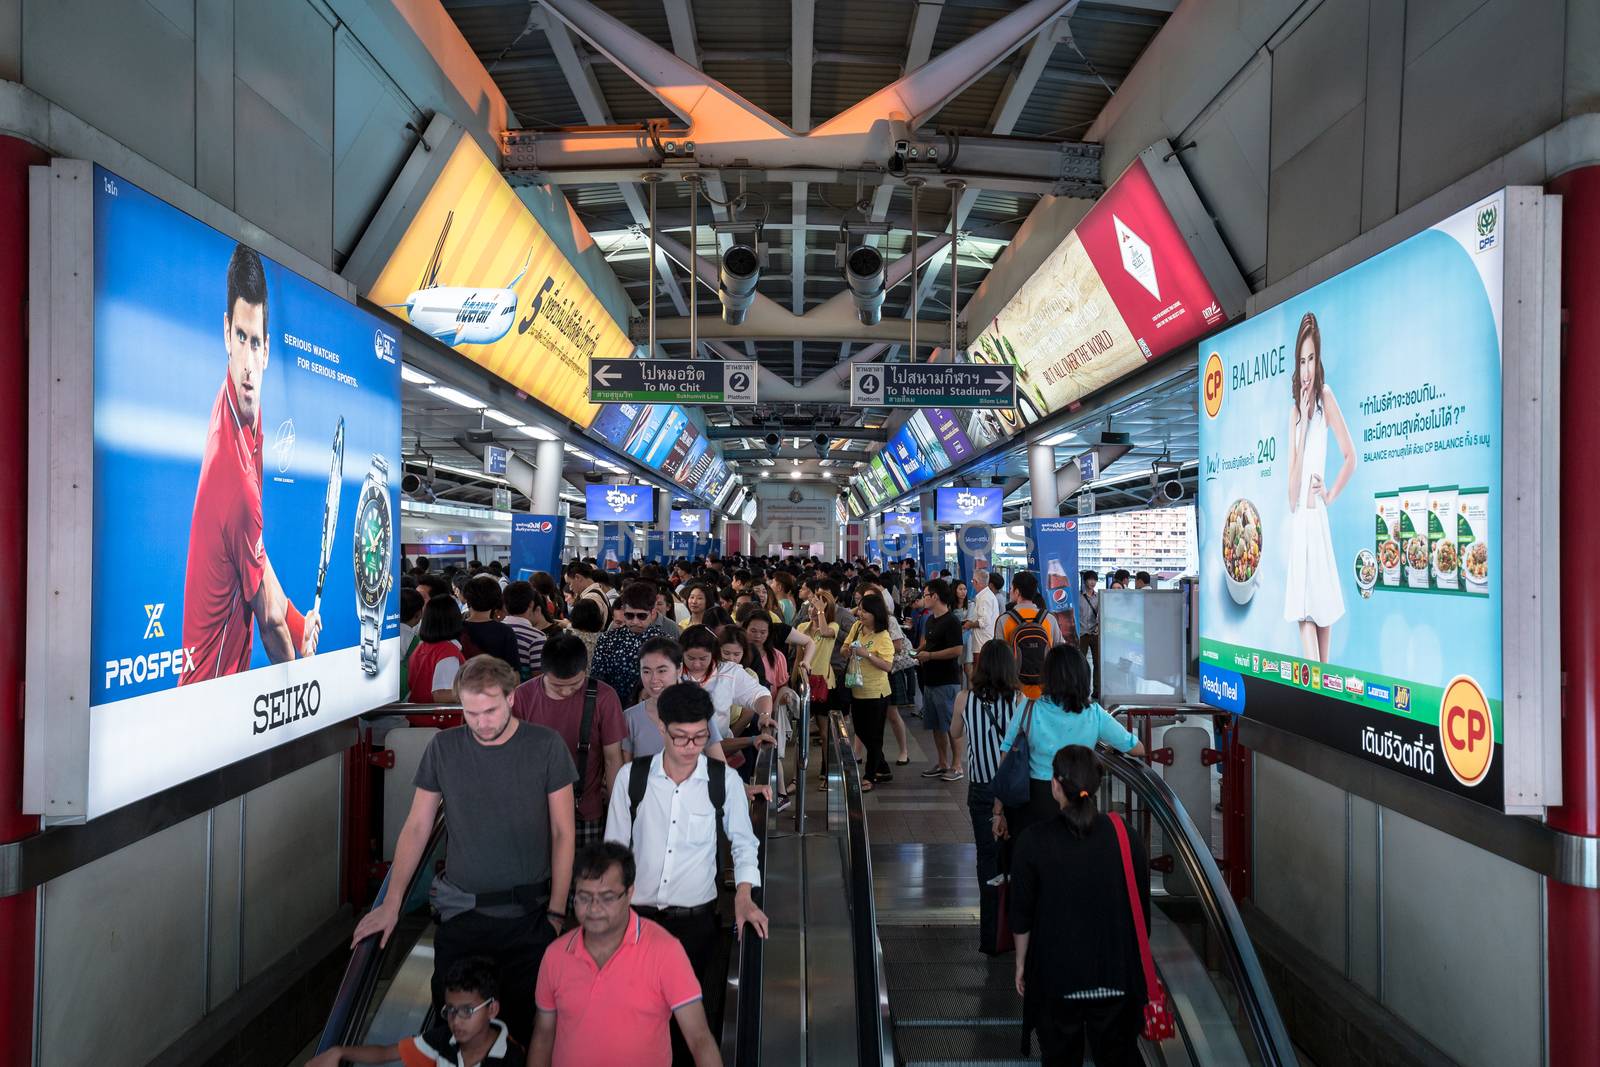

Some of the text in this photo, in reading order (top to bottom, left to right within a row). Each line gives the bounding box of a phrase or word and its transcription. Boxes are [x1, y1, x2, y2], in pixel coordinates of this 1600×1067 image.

[1479, 235, 1495, 250] CPF
[518, 276, 554, 335] 5
[284, 333, 340, 364] SERIOUS WATCHES
[1042, 367, 1058, 386] BUT
[1060, 352, 1081, 375] OVER
[1074, 344, 1092, 365] THE
[1086, 329, 1114, 356] WORLD
[297, 356, 359, 388] FOR SERIOUS SPORTS.
[639, 361, 705, 381] ไปหมอชิต
[733, 373, 745, 390] 2
[890, 366, 980, 385] ไปสนามกีฬาฯ
[1232, 345, 1286, 391] BALANCE
[643, 382, 701, 392] To Mo Chit
[862, 375, 875, 392] 4
[886, 386, 991, 396] To National Stadium
[1206, 370, 1221, 401] CP
[1257, 436, 1276, 463] 240
[1424, 442, 1433, 453] CP
[1434, 437, 1464, 451] BALANCE
[105, 646, 196, 689] PROSPEX
[1202, 674, 1237, 701] Ready Meal
[253, 679, 321, 735] SEIKO
[1447, 705, 1486, 753] CP
[1362, 726, 1435, 775] เติมชีวิตที่ดี
